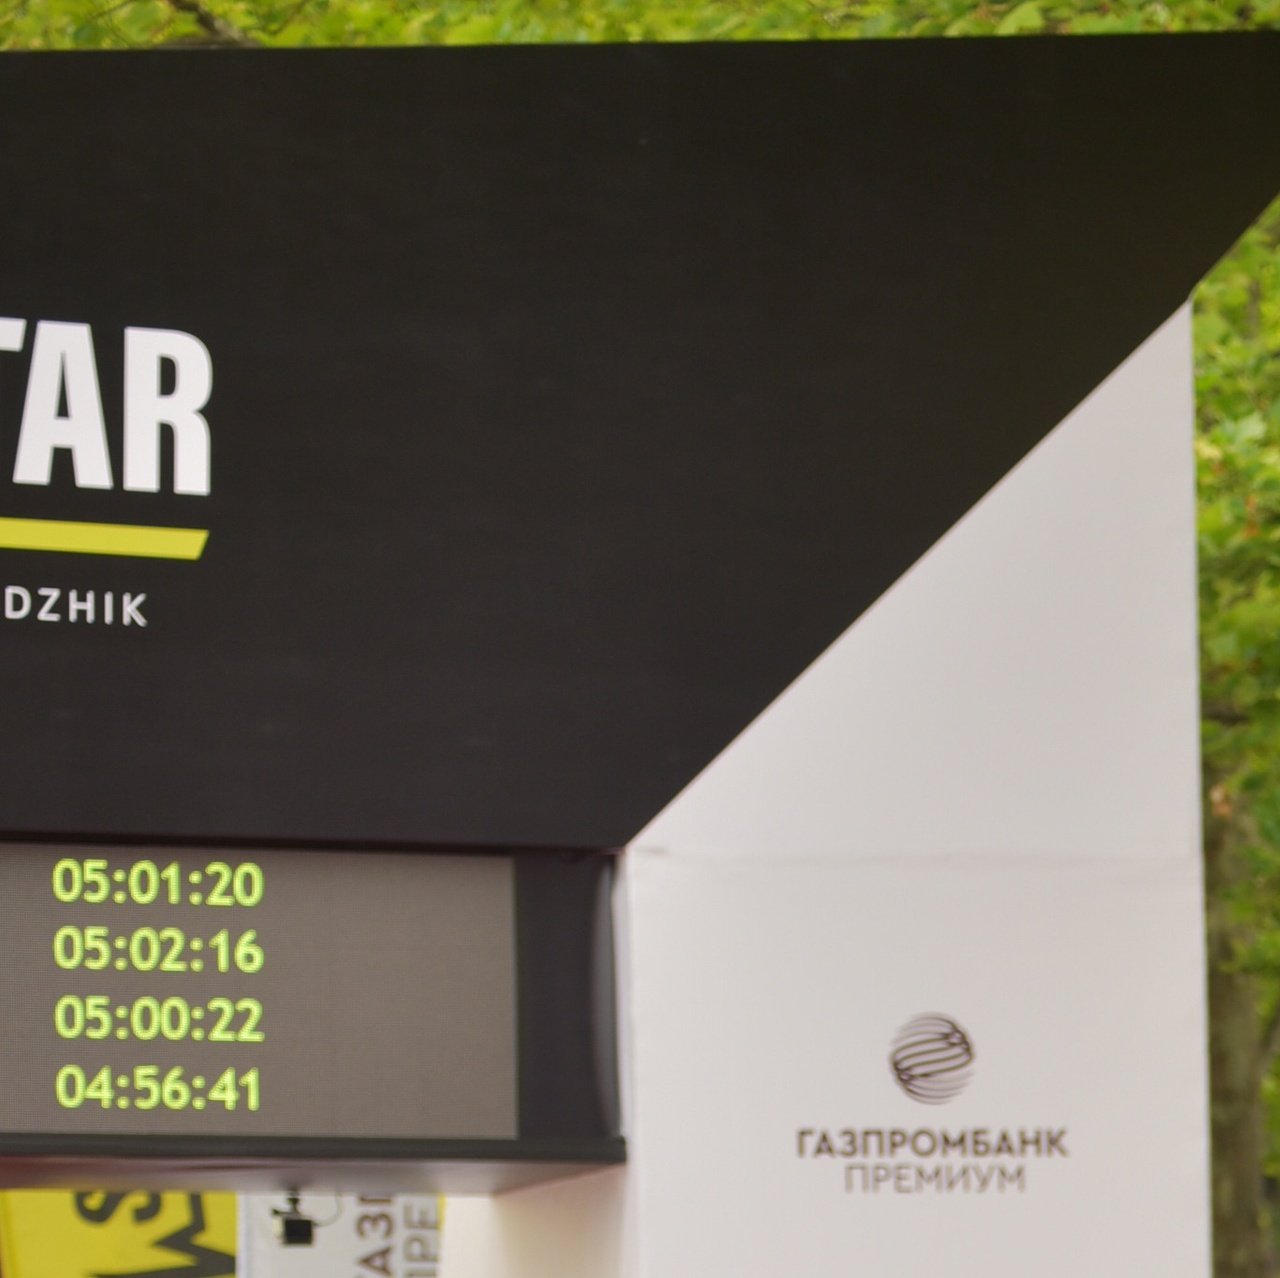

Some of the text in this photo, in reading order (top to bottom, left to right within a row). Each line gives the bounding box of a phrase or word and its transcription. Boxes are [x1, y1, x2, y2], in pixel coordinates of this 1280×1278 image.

[4, 585, 148, 627] DZHIK
[52, 858, 264, 907] 05:01:20
[53, 925, 264, 973] 05:02:16
[54, 995, 265, 1042] 05:00:22
[55, 1064, 260, 1111] 04:56:41
[796, 1127, 1069, 1158] ГАЗПРОМБАНК
[844, 1163, 1026, 1193] ПРЕМИУМ
